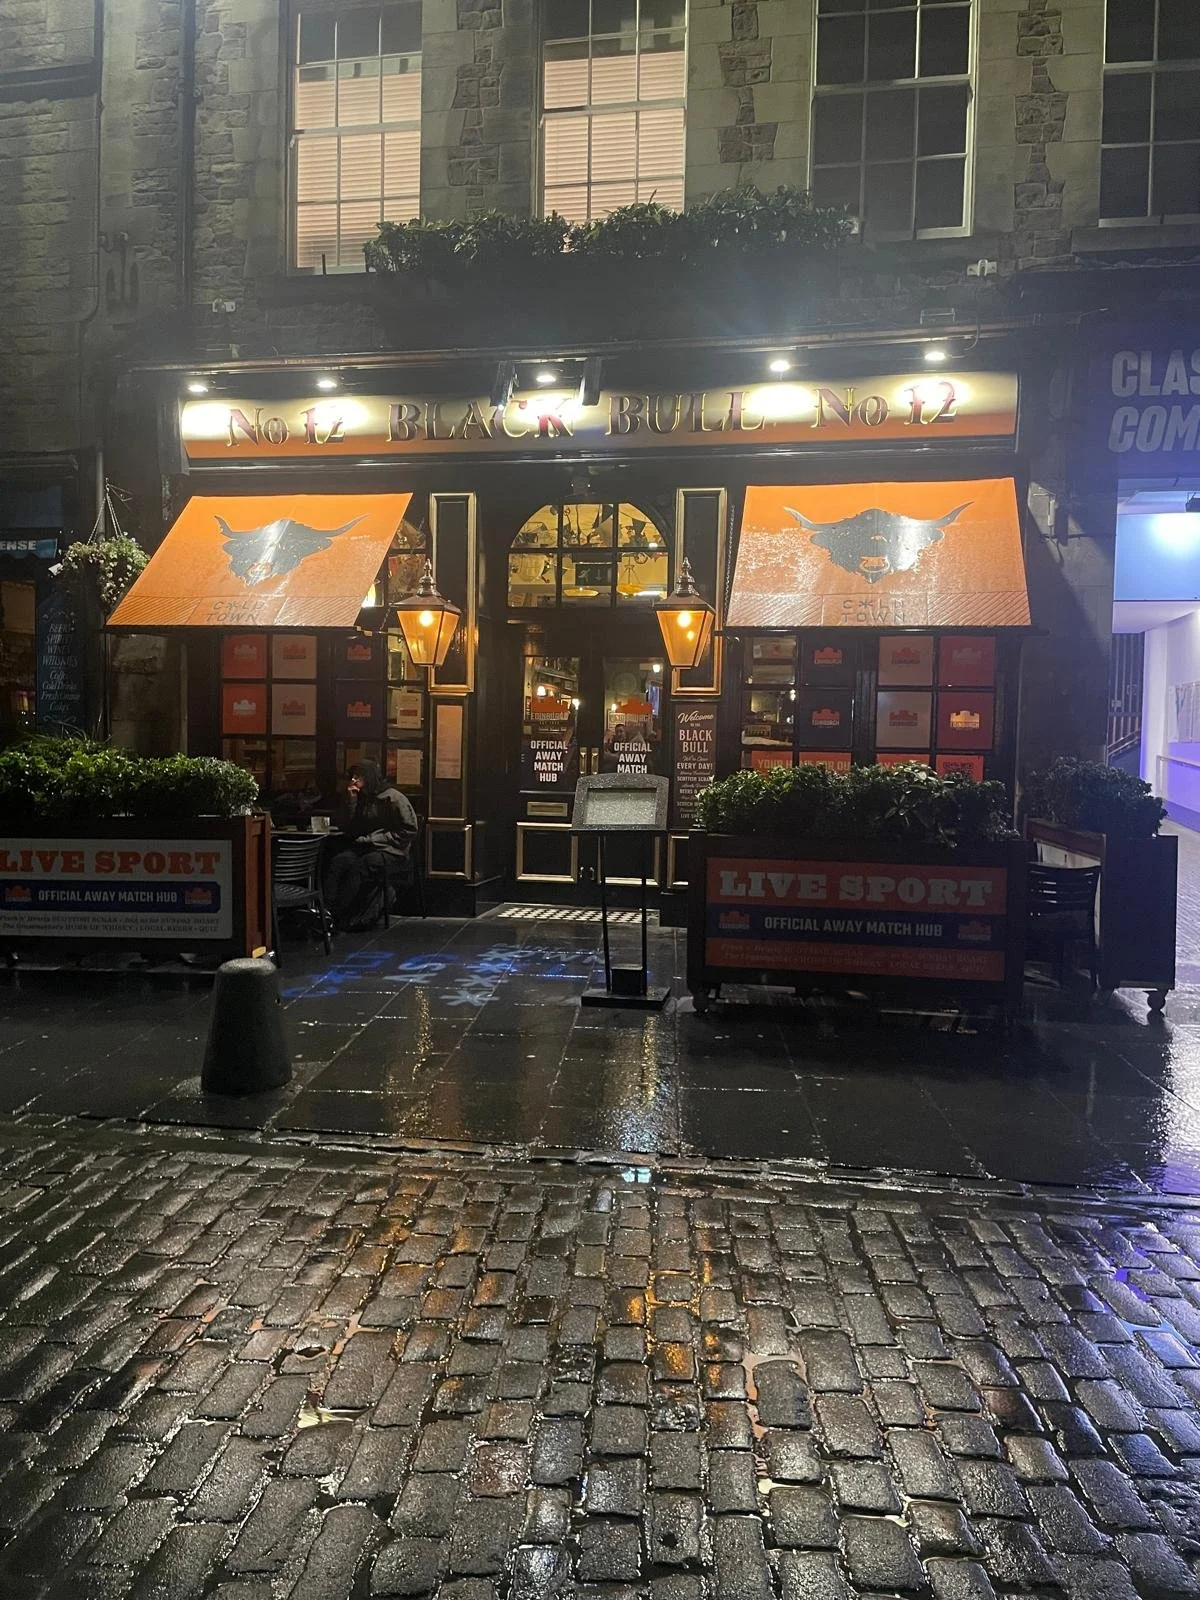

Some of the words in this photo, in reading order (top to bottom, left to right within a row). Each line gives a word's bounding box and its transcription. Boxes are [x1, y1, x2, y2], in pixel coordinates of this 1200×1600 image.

[226, 406, 291, 447] No
[301, 405, 346, 444] 12
[385, 397, 574, 443] BLACK
[604, 391, 765, 436] BULL
[810, 387, 892, 428] No
[903, 381, 958, 426] 12
[206, 612, 259, 622] TOWN
[843, 612, 905, 622] TOWN
[677, 711, 714, 724] Welcome
[679, 729, 713, 741] BLACK
[530, 740, 568, 750] OFFICIAL
[613, 742, 652, 752] OFFICIAL
[682, 741, 709, 753] BULL
[535, 751, 562, 761] AWAY
[618, 754, 646, 763] AWAY
[533, 762, 564, 772] MATCH
[617, 765, 648, 774] MATCH
[539, 772, 558, 782] HUB
[0, 850, 85, 874] LIVE
[95, 851, 221, 875] SPORT
[719, 871, 827, 900] LIVE
[839, 874, 992, 906] SPORT
[38, 889, 82, 902] OFFICIAL
[84, 890, 118, 902] AWAY
[118, 890, 154, 903] MATCH
[156, 891, 178, 903] HUB
[764, 916, 820, 932] OFFICIAL
[822, 918, 862, 933] AWAY
[866, 920, 912, 936] MATCH
[915, 922, 942, 937] HUB
